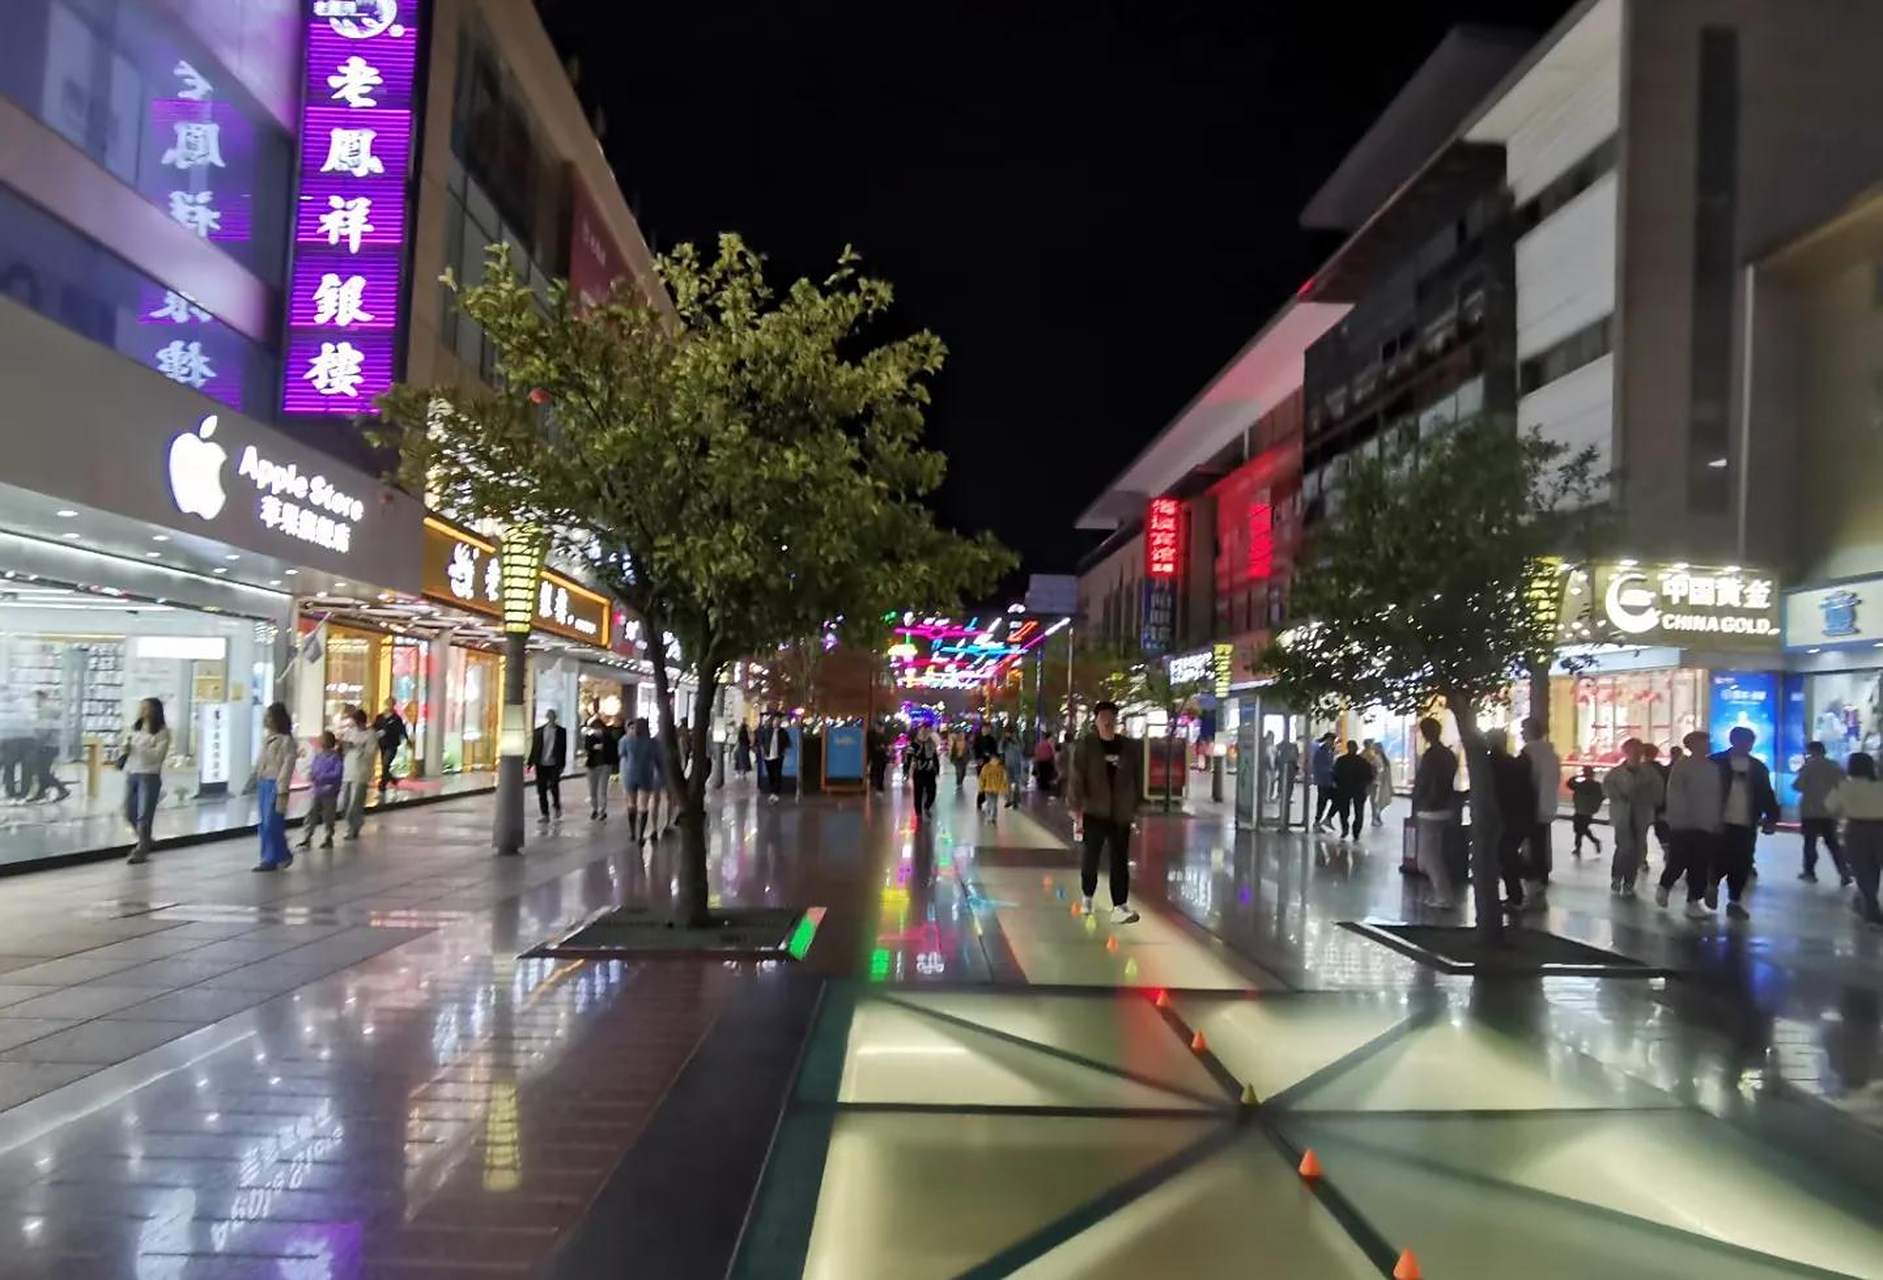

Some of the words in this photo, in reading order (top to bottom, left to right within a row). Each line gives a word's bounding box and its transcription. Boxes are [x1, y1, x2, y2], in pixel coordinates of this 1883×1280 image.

[303, 55, 385, 397] 老鳳祥銀樓
[239, 445, 309, 499] Apple
[309, 475, 364, 521] Store
[1661, 574, 1773, 608] 中国黄金
[1661, 613, 1719, 632] CHINA
[1719, 616, 1771, 634] GOLD
